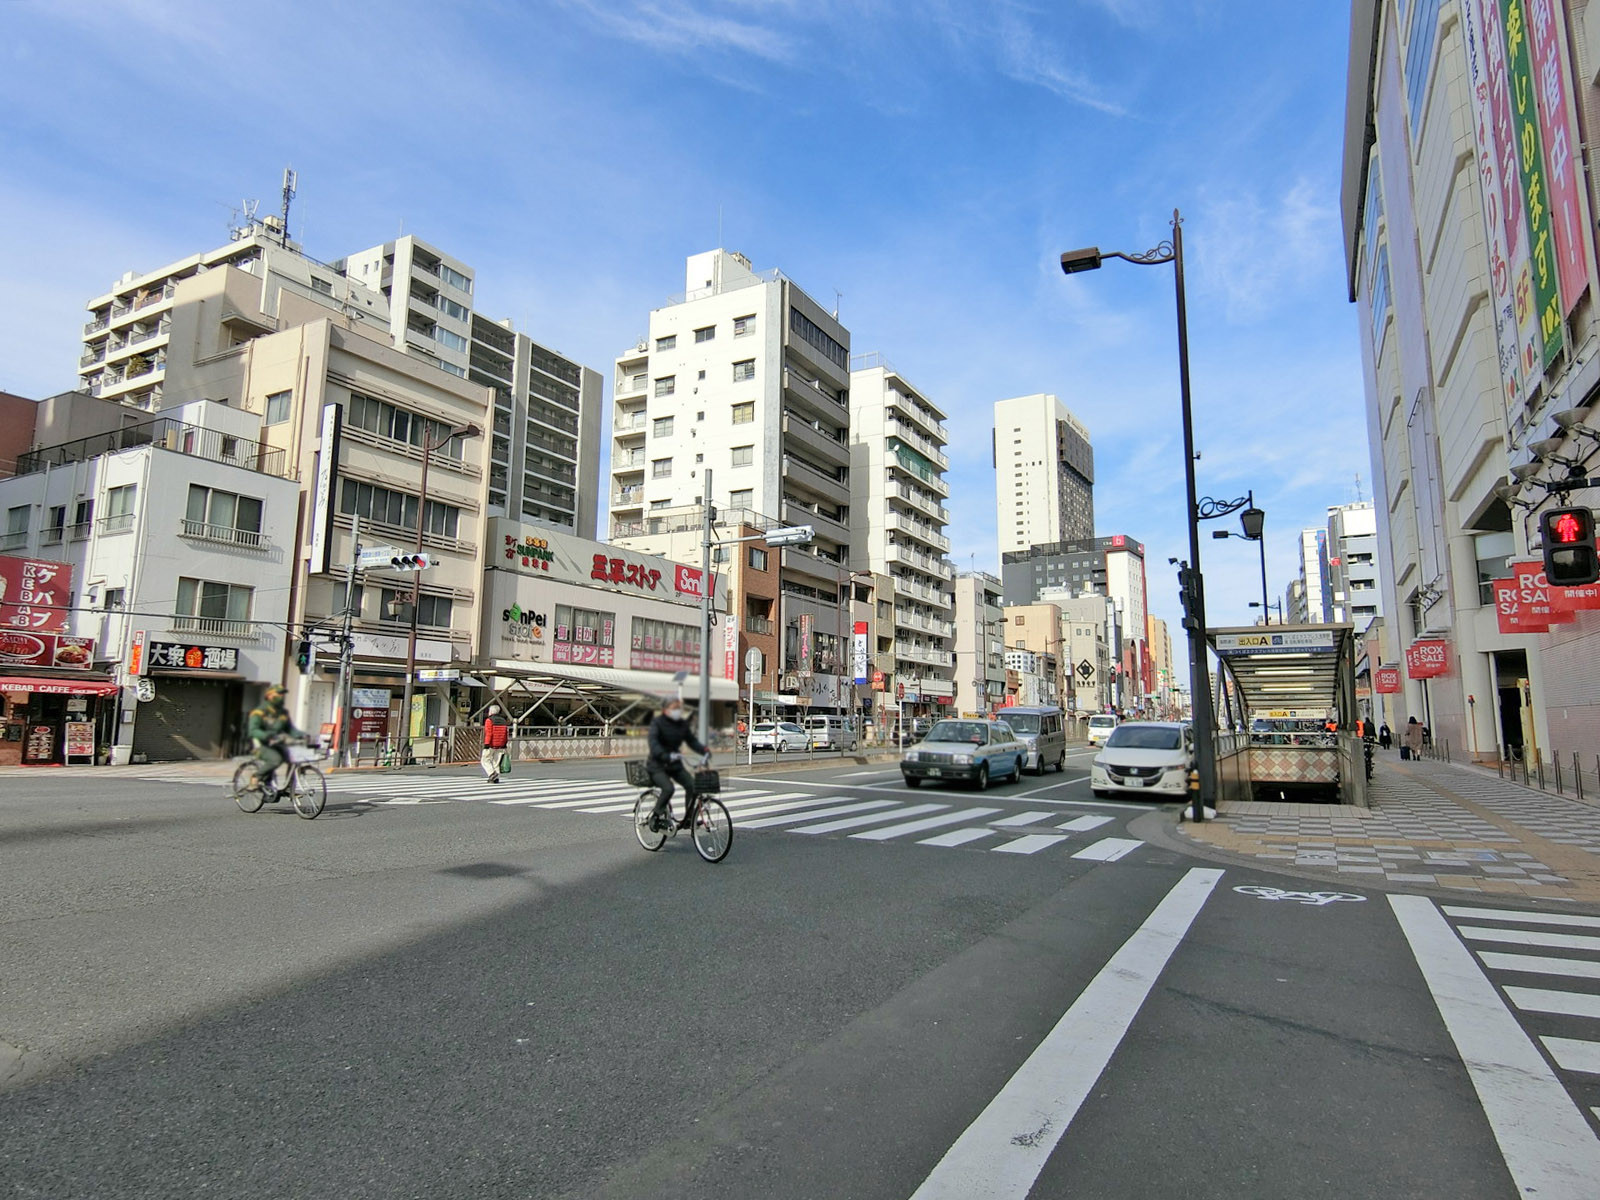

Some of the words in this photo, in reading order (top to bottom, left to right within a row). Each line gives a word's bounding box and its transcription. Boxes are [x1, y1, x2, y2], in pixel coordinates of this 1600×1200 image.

[591, 553, 661, 591] 三平ストア
[1519, 573, 1549, 589] RO
[32, 568, 58, 628] ケバブ
[1238, 636, 1269, 646] 出入口A
[150, 643, 186, 667] 大衆
[203, 647, 236, 670] 酒場
[572, 644, 614, 663] サンキ
[1419, 646, 1444, 655] ROX
[1420, 654, 1445, 662] SALE
[1, 683, 35, 692] KEBAB
[38, 685, 71, 694] CAFFE
